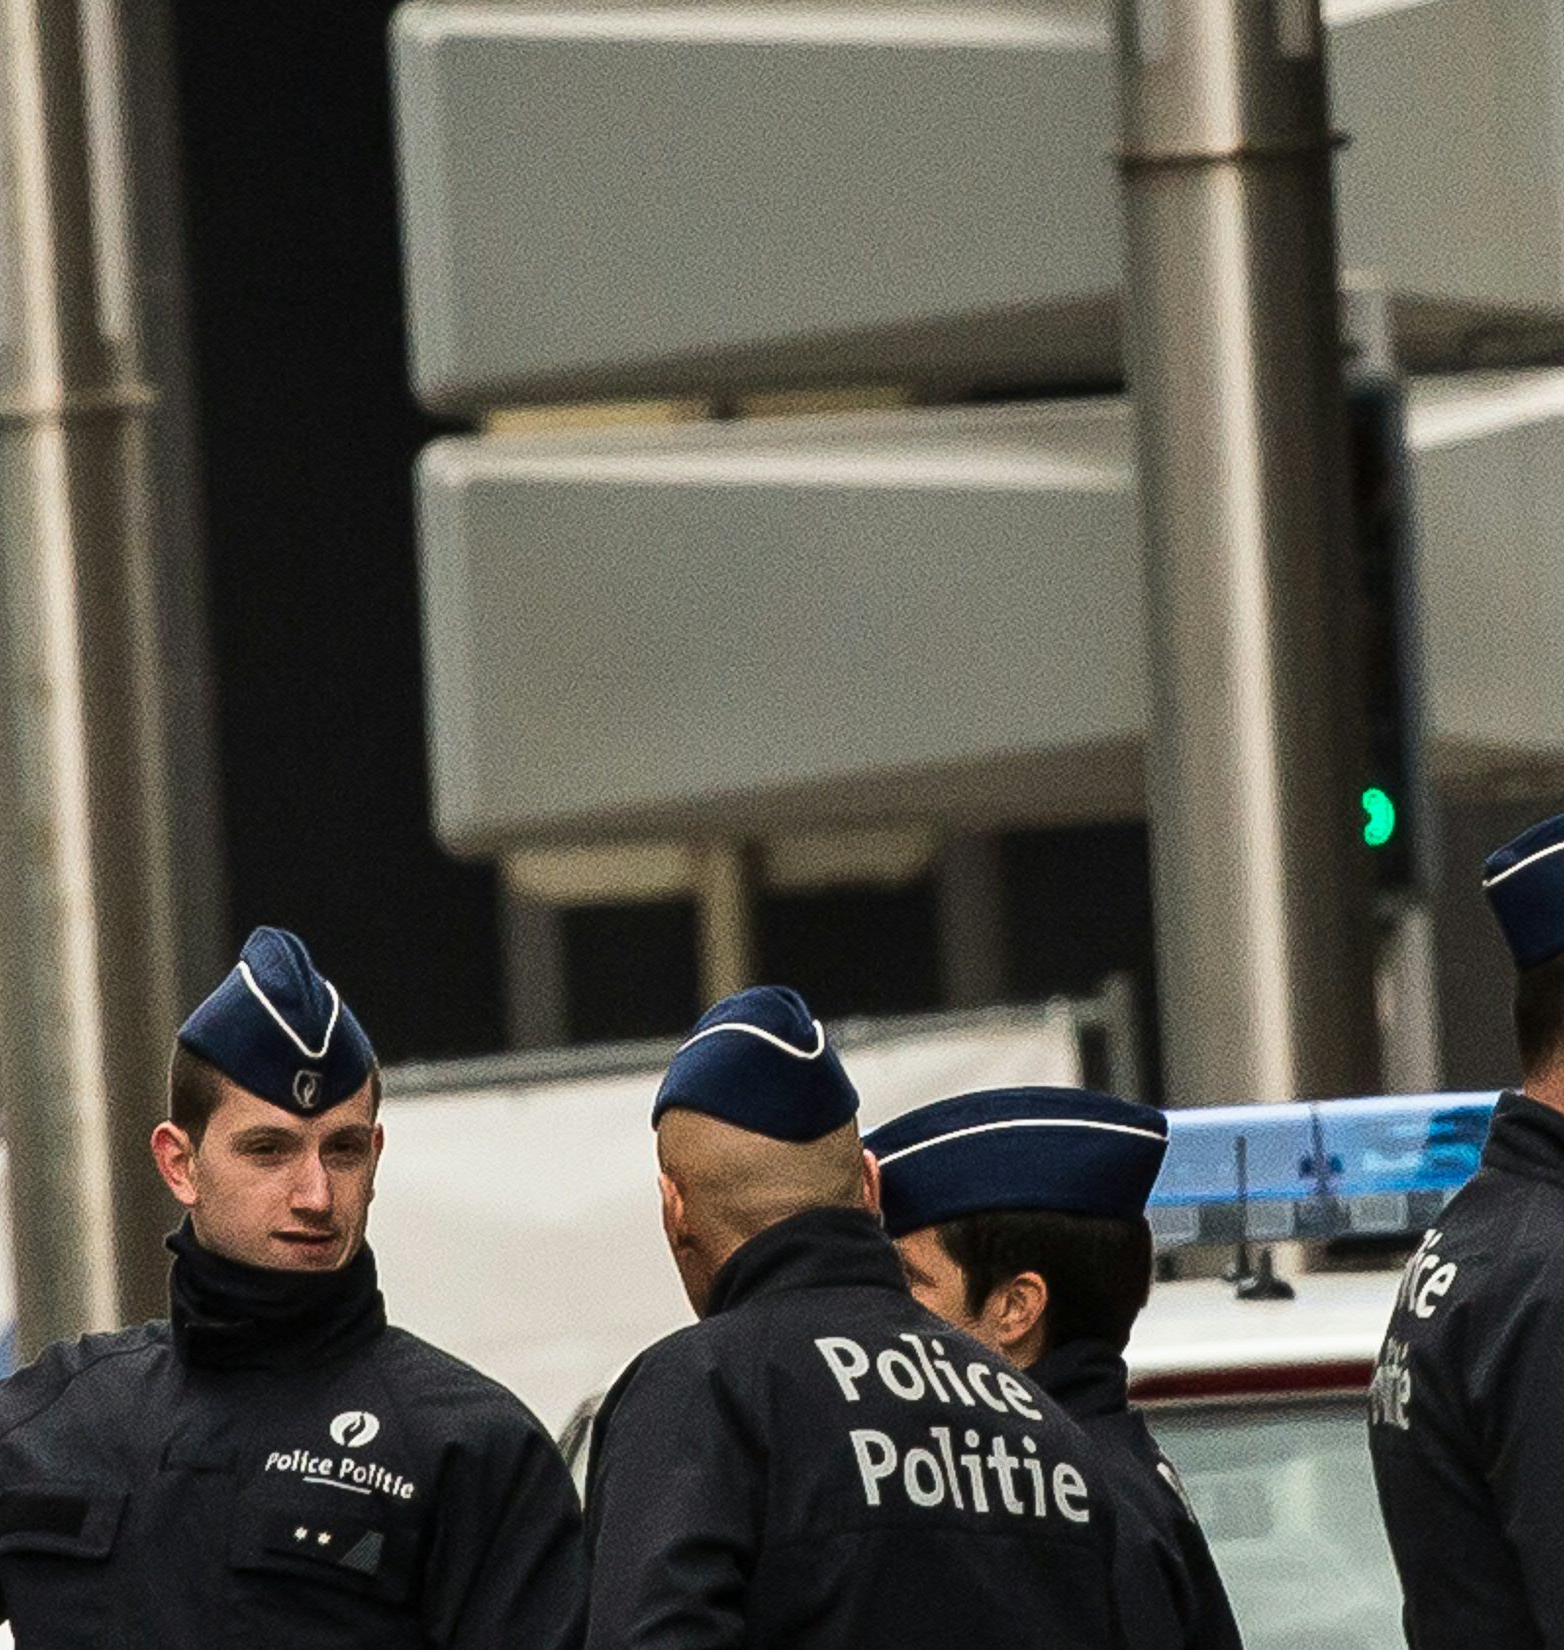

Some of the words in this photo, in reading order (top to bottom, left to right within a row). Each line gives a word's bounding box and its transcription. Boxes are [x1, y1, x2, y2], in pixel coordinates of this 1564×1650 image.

[813, 1332, 1043, 1420] Police
[264, 1449, 333, 1475] Police
[339, 1457, 415, 1499] Politie
[848, 1426, 1090, 1523] Politie
